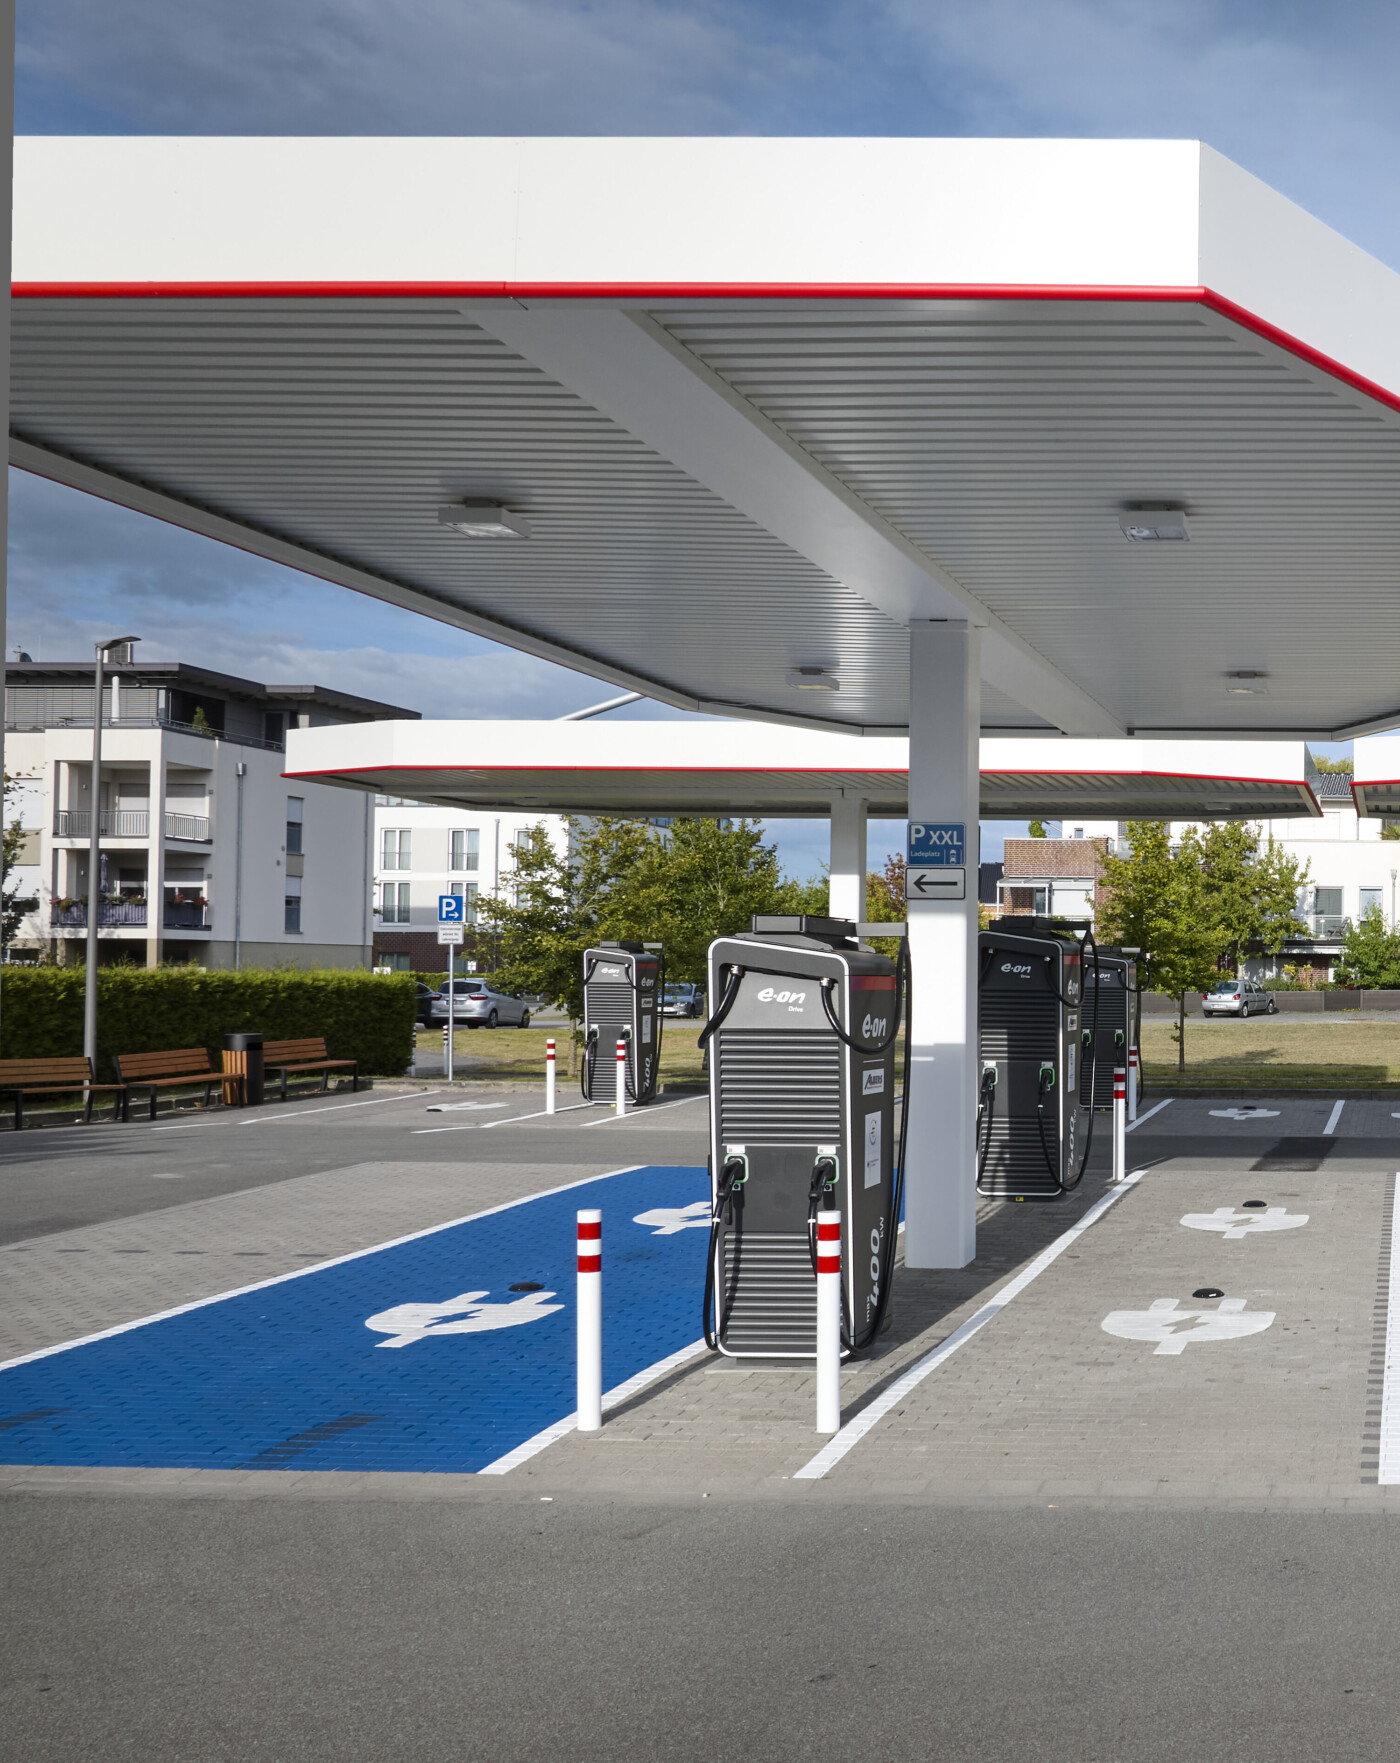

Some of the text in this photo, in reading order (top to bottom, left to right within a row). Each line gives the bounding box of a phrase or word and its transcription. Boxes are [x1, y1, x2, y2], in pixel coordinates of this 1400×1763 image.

[911, 825, 962, 845] P XXL
[442, 898, 456, 918] P
[870, 1228, 880, 1307] 400
